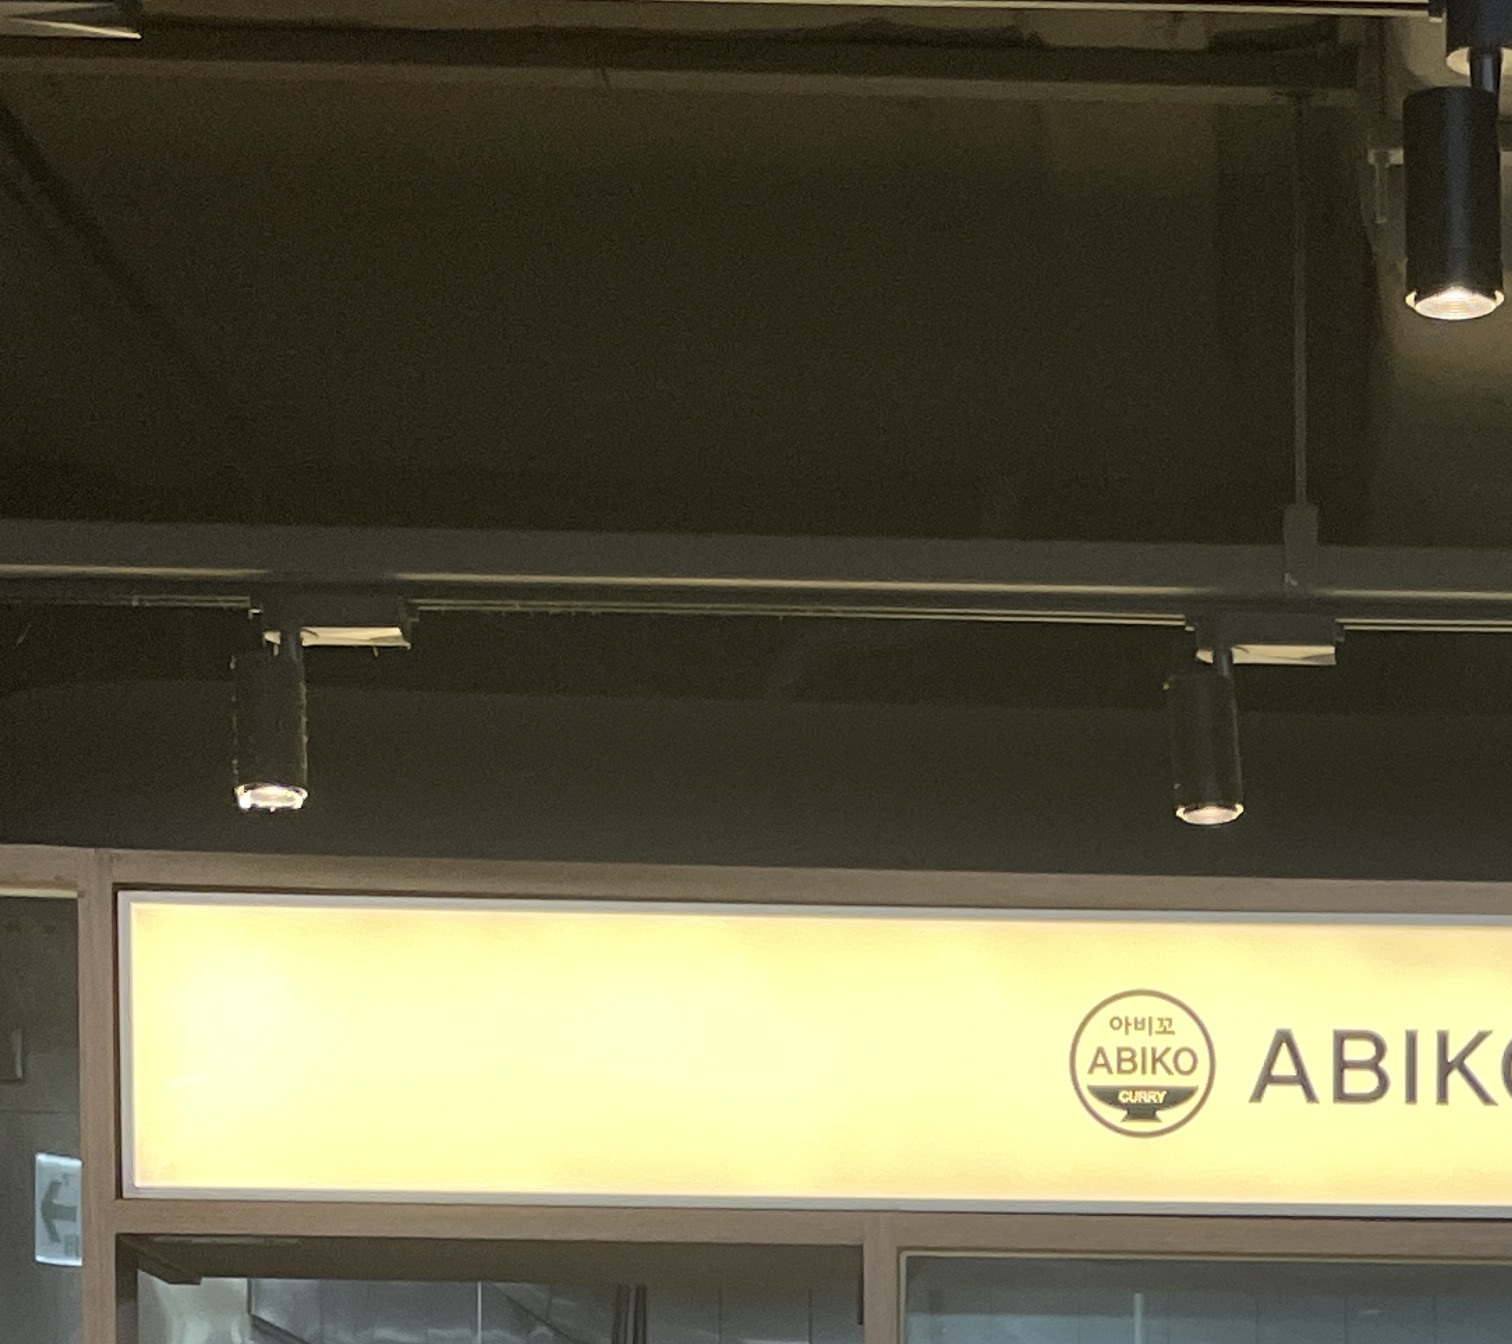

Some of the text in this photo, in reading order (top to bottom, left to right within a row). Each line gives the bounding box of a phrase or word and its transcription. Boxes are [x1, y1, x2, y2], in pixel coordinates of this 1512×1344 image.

[1109, 1015, 1176, 1037] 아비꼬
[1087, 1046, 1199, 1076] ABIKO
[1118, 1090, 1167, 1104] CURRY
